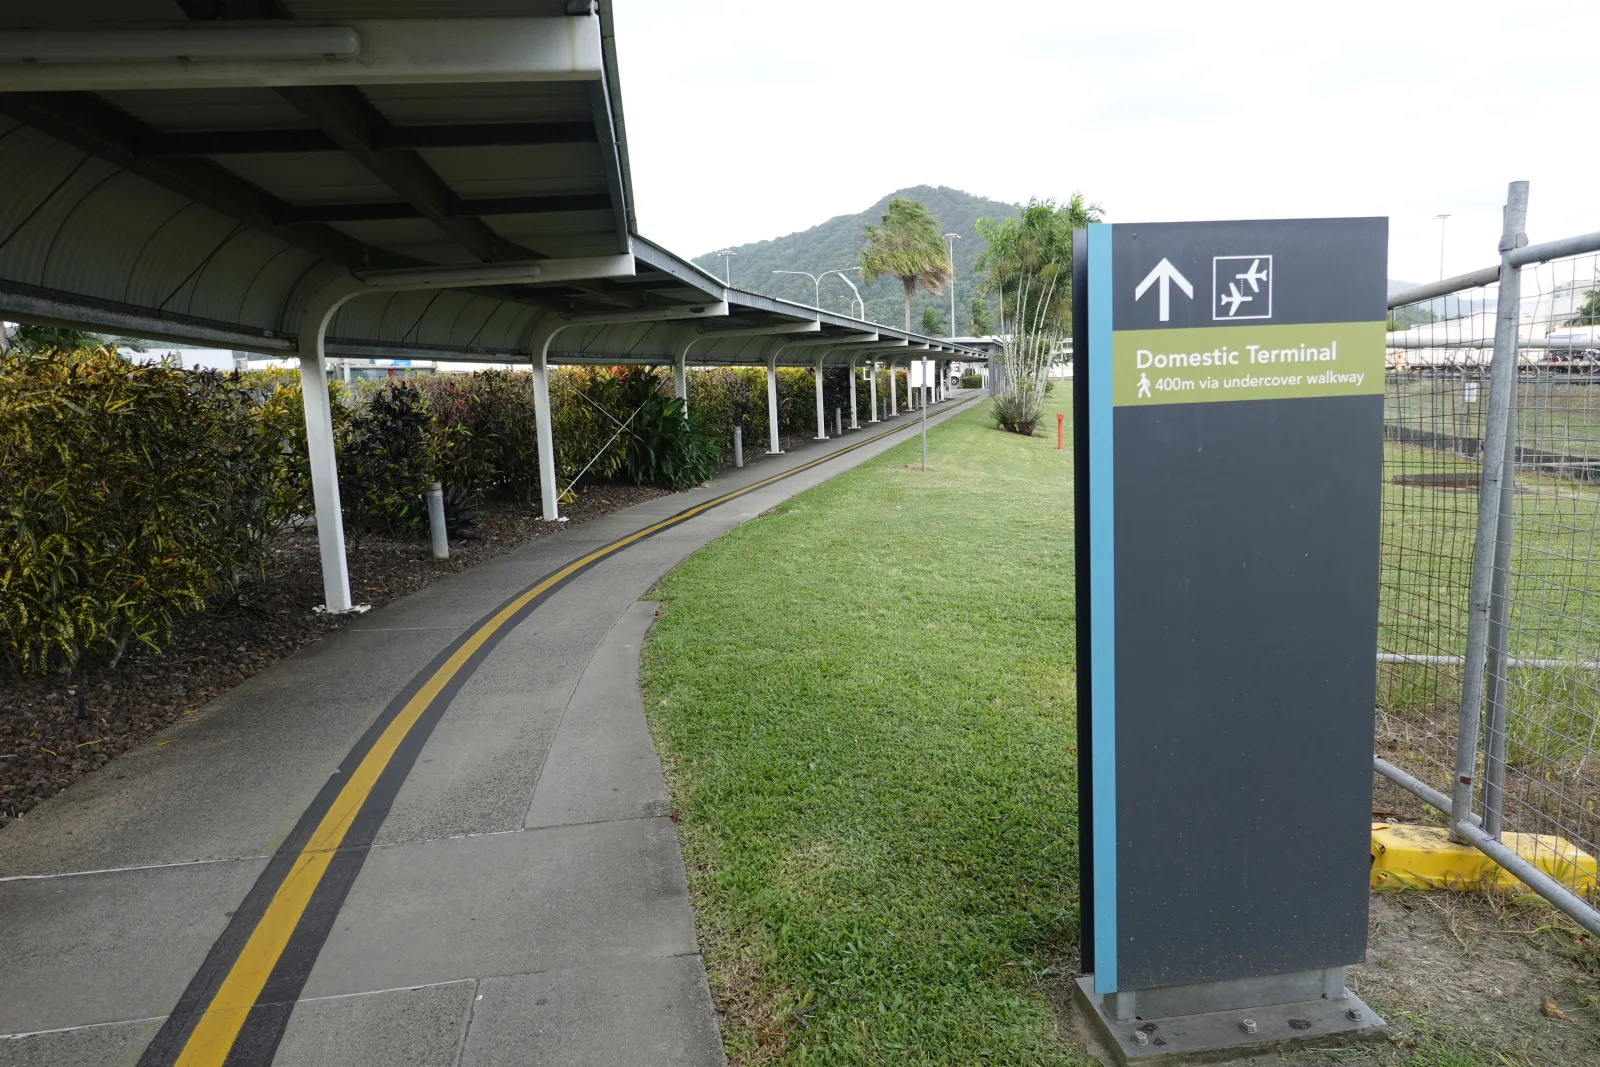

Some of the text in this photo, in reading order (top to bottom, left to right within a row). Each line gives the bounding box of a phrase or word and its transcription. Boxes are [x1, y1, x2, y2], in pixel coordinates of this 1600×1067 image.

[1136, 340, 1337, 369] Domestic Terminal
[1155, 370, 1365, 391] 400m via undercover walkway
